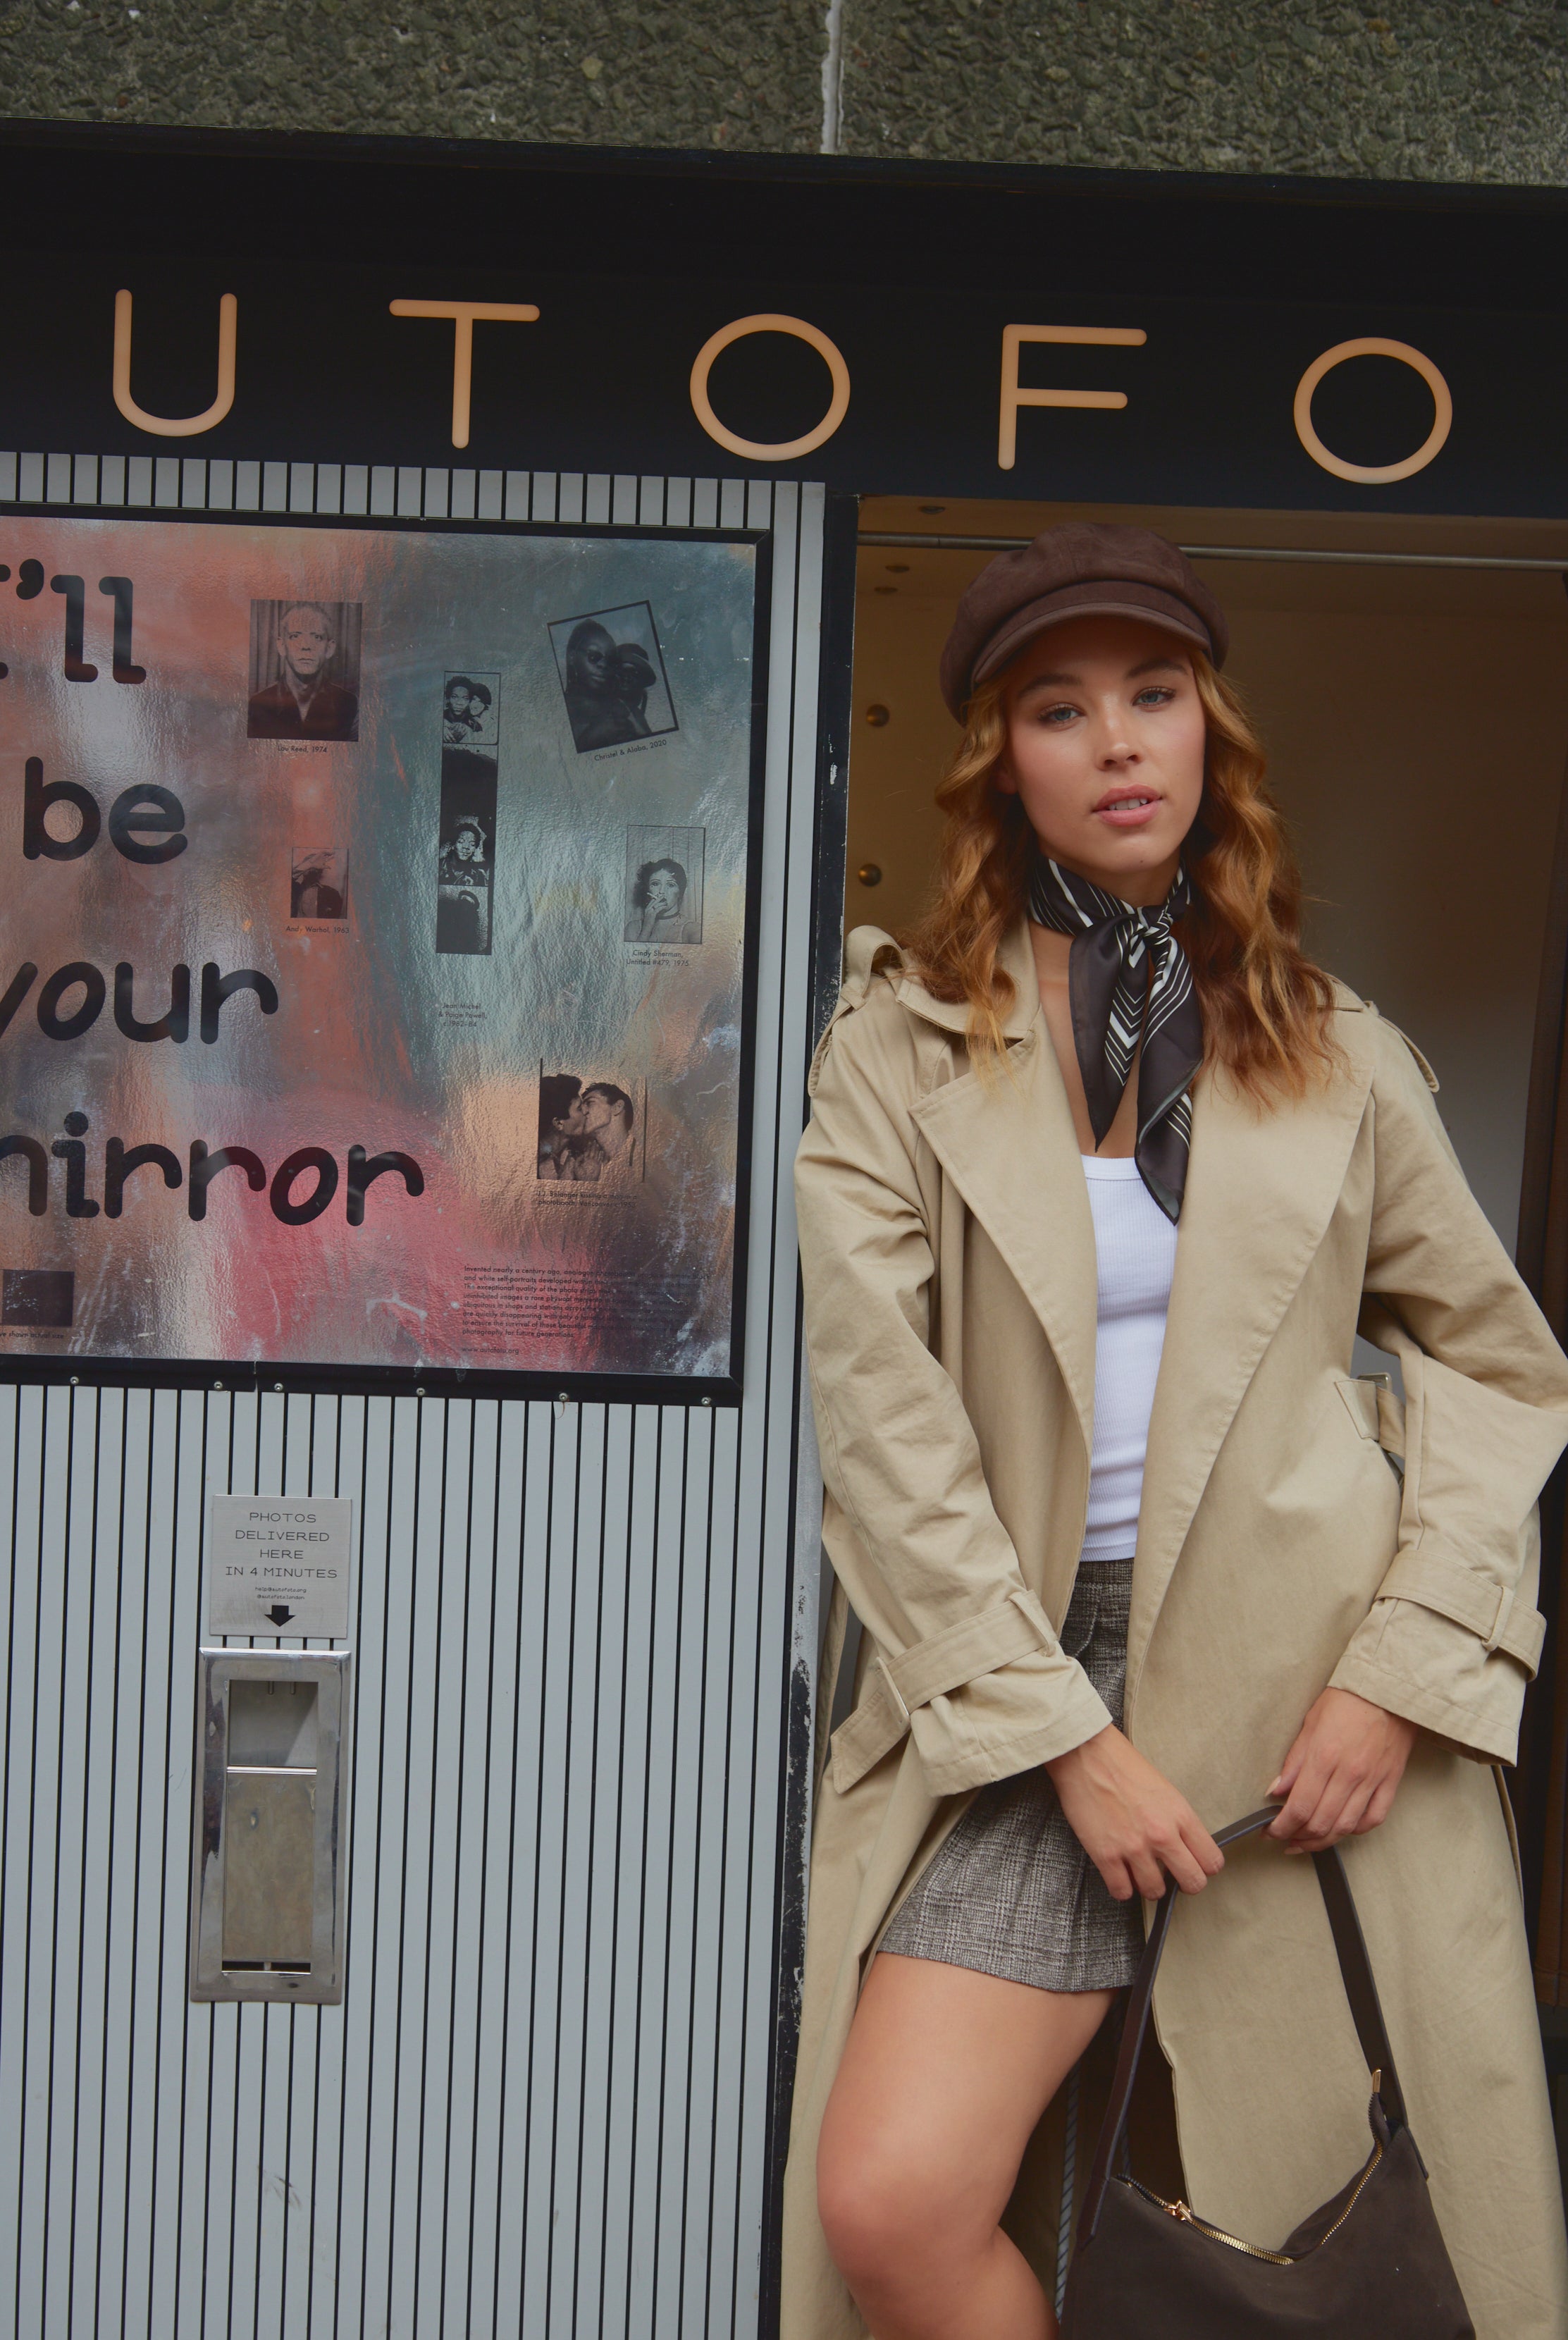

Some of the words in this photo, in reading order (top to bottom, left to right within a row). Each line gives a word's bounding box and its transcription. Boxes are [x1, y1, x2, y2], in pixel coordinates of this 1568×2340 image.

[113, 289, 1452, 484] UTOFO
[0, 559, 146, 684] 'll
[650, 739, 667, 749] 2020
[23, 756, 188, 864] be
[632, 949, 651, 958] Cindy
[653, 949, 684, 959] Sherman,
[445, 1011, 463, 1019] Paige
[581, 1191, 601, 1200] kissing
[498, 1276, 536, 1284] self-portraits
[538, 1277, 572, 1286] developed
[463, 1301, 495, 1310] ubiquitous
[500, 1312, 542, 1320] disappearing
[249, 1512, 316, 1523] PHOTOS
[235, 1529, 330, 1541] DELIVERED
[260, 1548, 304, 1560] HERE
[226, 1566, 244, 1576] IN
[249, 1567, 258, 1577] 4
[264, 1568, 338, 1579] MINUTES
